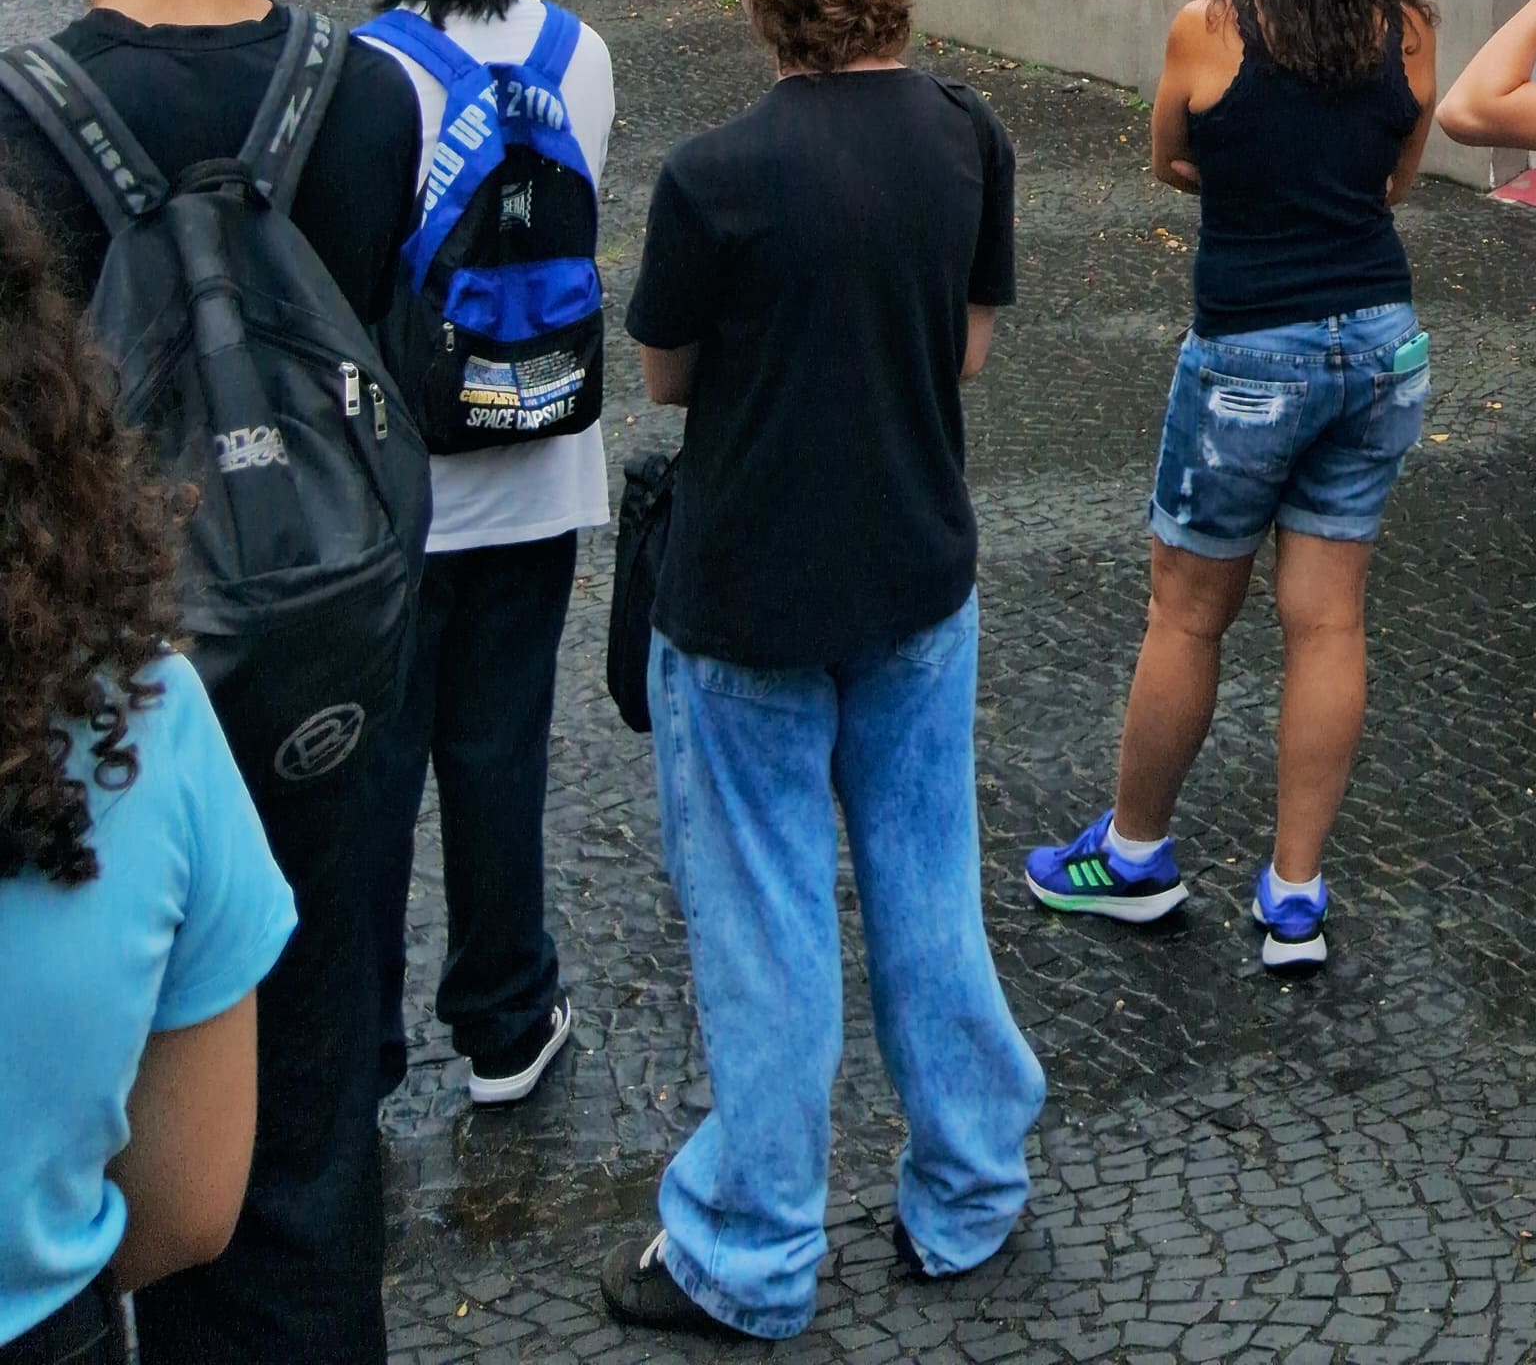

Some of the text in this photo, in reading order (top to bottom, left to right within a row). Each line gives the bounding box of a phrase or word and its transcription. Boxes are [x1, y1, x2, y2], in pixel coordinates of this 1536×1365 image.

[421, 142, 465, 229] UILD
[448, 104, 492, 151] UP
[466, 395, 577, 430] SPACE CAPSULE
